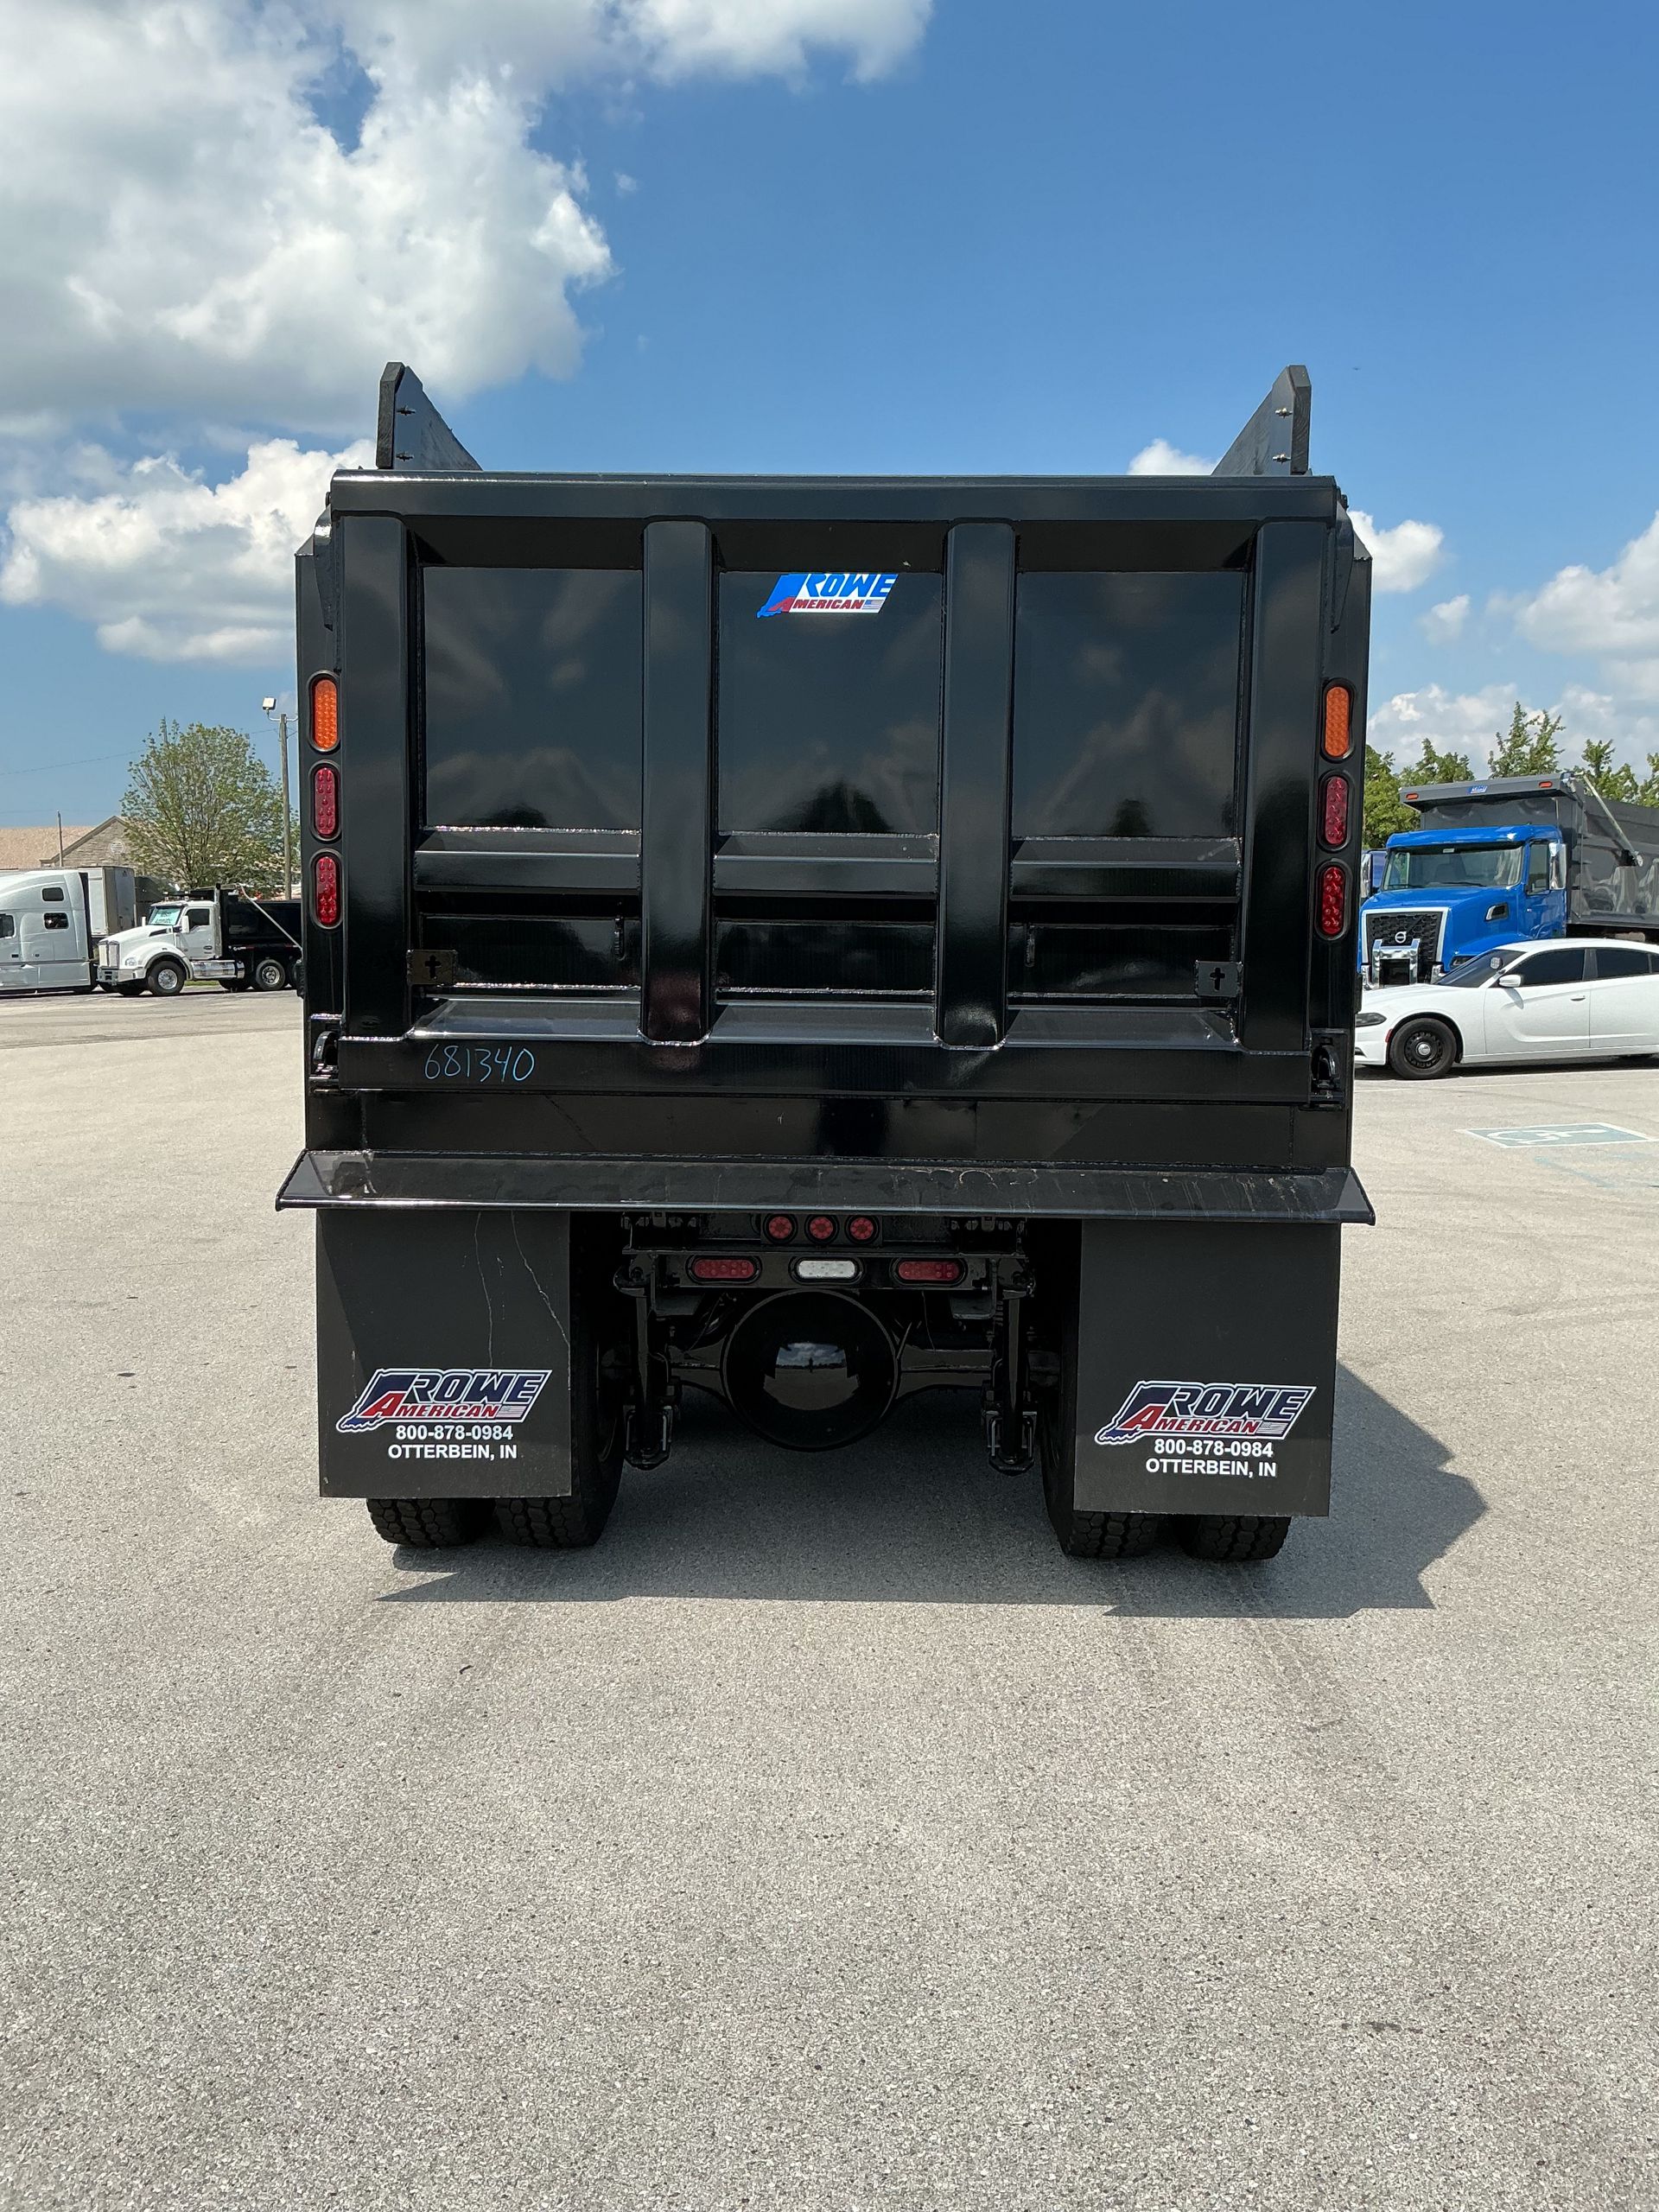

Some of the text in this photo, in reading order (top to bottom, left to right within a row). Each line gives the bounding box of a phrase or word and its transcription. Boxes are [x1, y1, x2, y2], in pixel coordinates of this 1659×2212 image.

[804, 573, 899, 598] ROWE
[767, 595, 865, 613] AMERICAN
[424, 1043, 535, 1083] 681340
[408, 1373, 546, 1404] ROWE
[359, 1390, 502, 1419] AMERICAN
[1172, 1385, 1309, 1421] ROWE
[1117, 1403, 1264, 1435] AMERICAN
[396, 1425, 513, 1440] 800-878-0984
[388, 1444, 517, 1461] OTTERBEIN, IN
[1154, 1439, 1274, 1458] 800-878-0984
[1146, 1458, 1276, 1478] OTTERBEIN, IN
